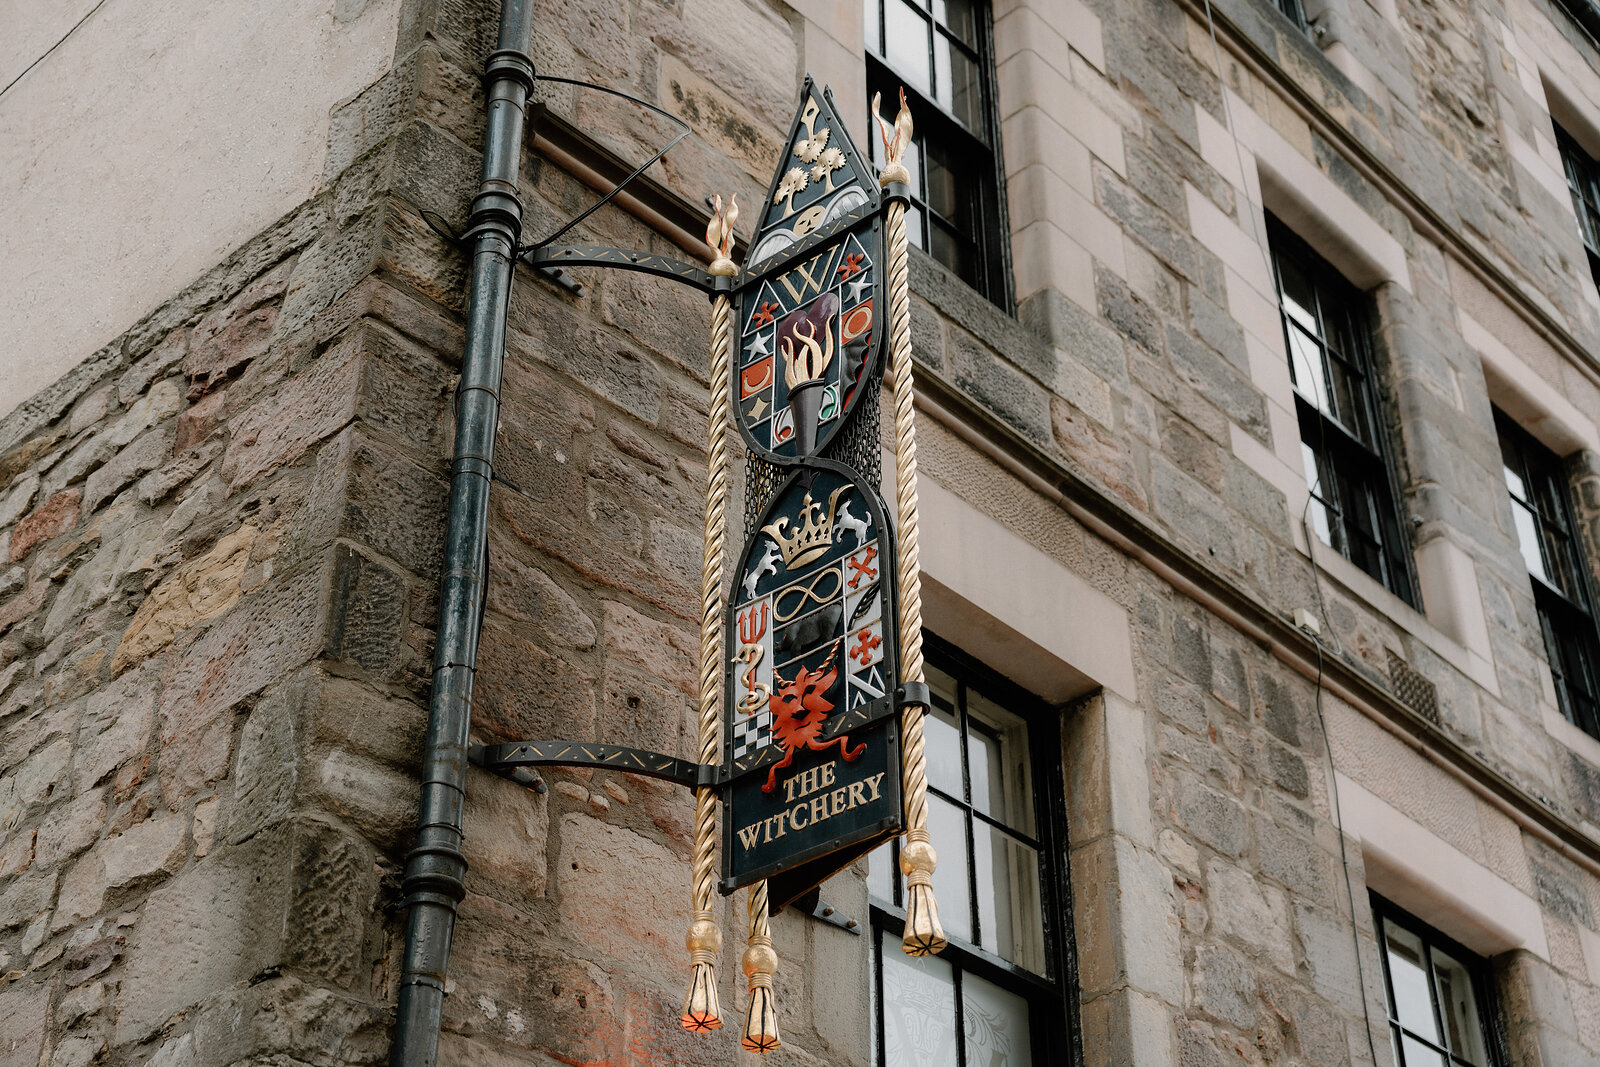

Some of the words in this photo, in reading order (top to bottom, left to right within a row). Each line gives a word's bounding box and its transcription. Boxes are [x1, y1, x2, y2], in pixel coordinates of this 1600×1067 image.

[776, 244, 840, 304] W
[737, 772, 885, 851] WITCHERY
[783, 761, 836, 803] THE
